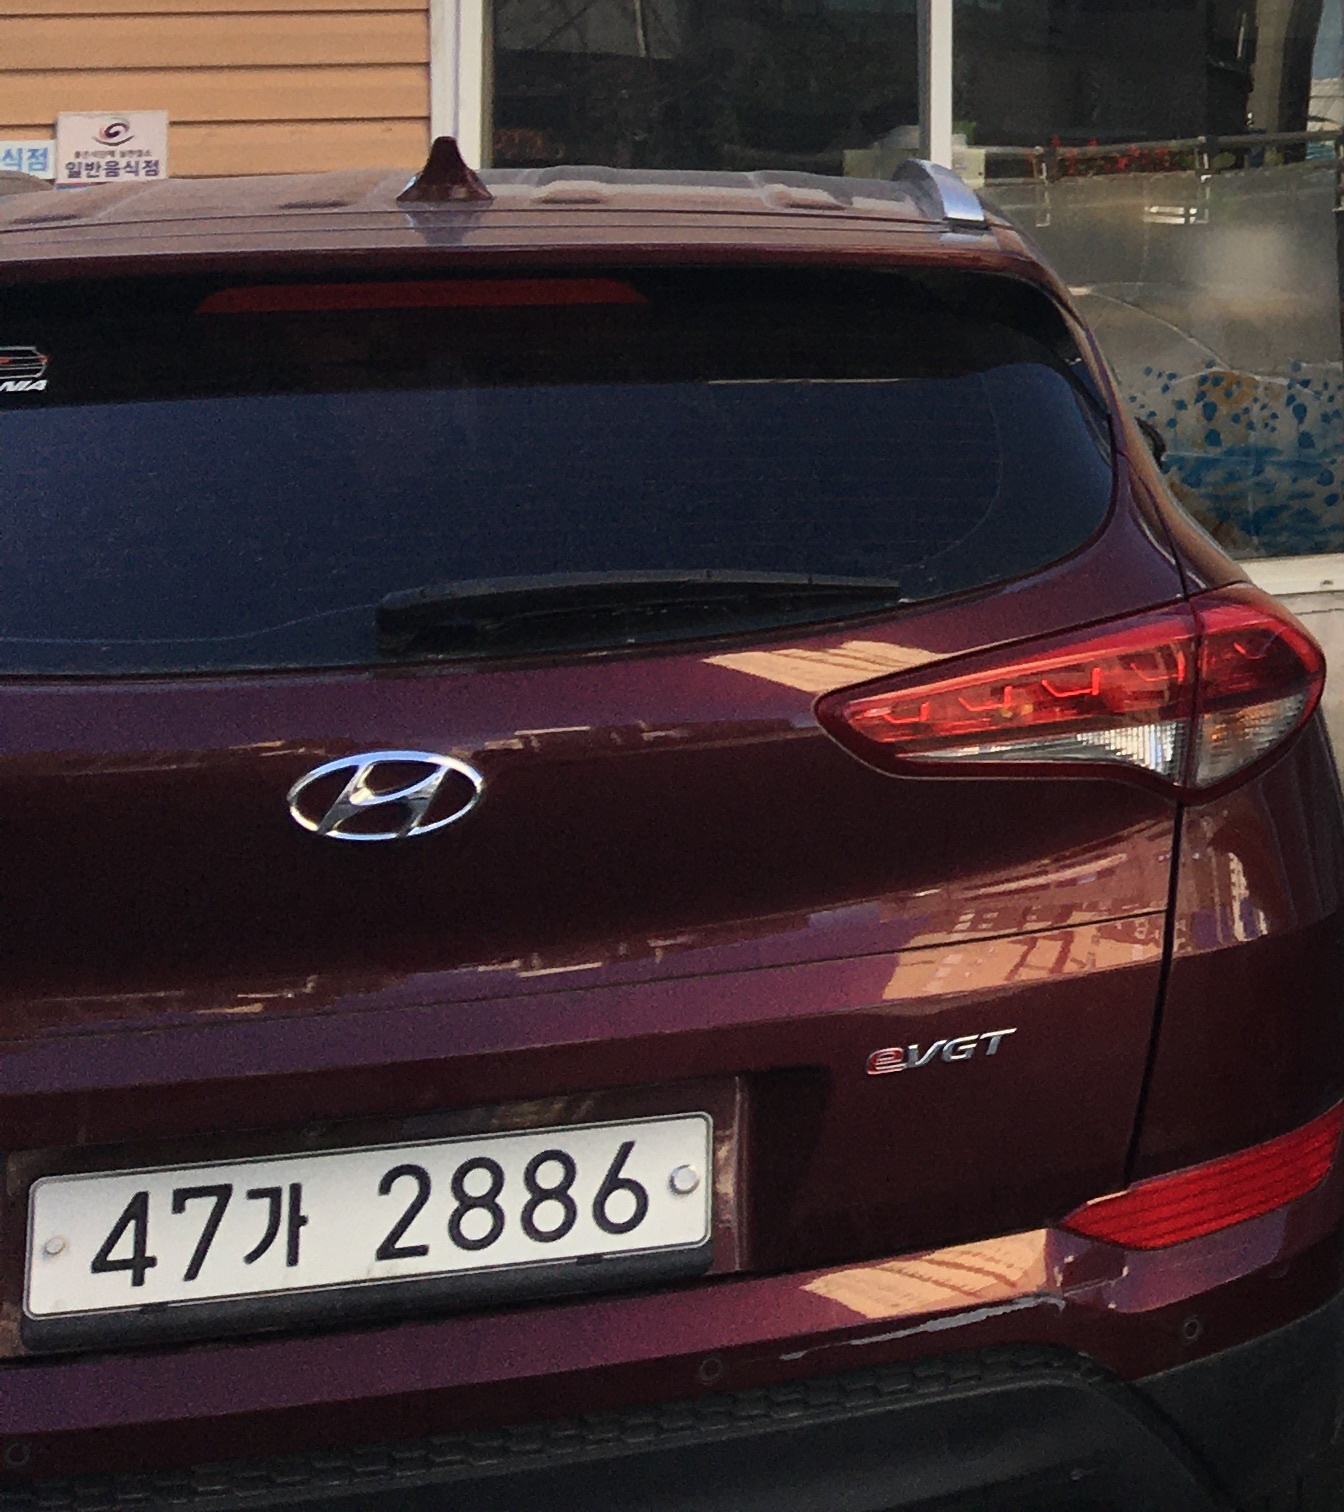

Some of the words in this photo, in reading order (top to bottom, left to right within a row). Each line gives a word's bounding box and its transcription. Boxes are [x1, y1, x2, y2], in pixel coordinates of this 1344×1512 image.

[65, 159, 160, 179] 일반음식점
[90, 1181, 309, 1287] 47가
[374, 1140, 651, 1262] 2886
